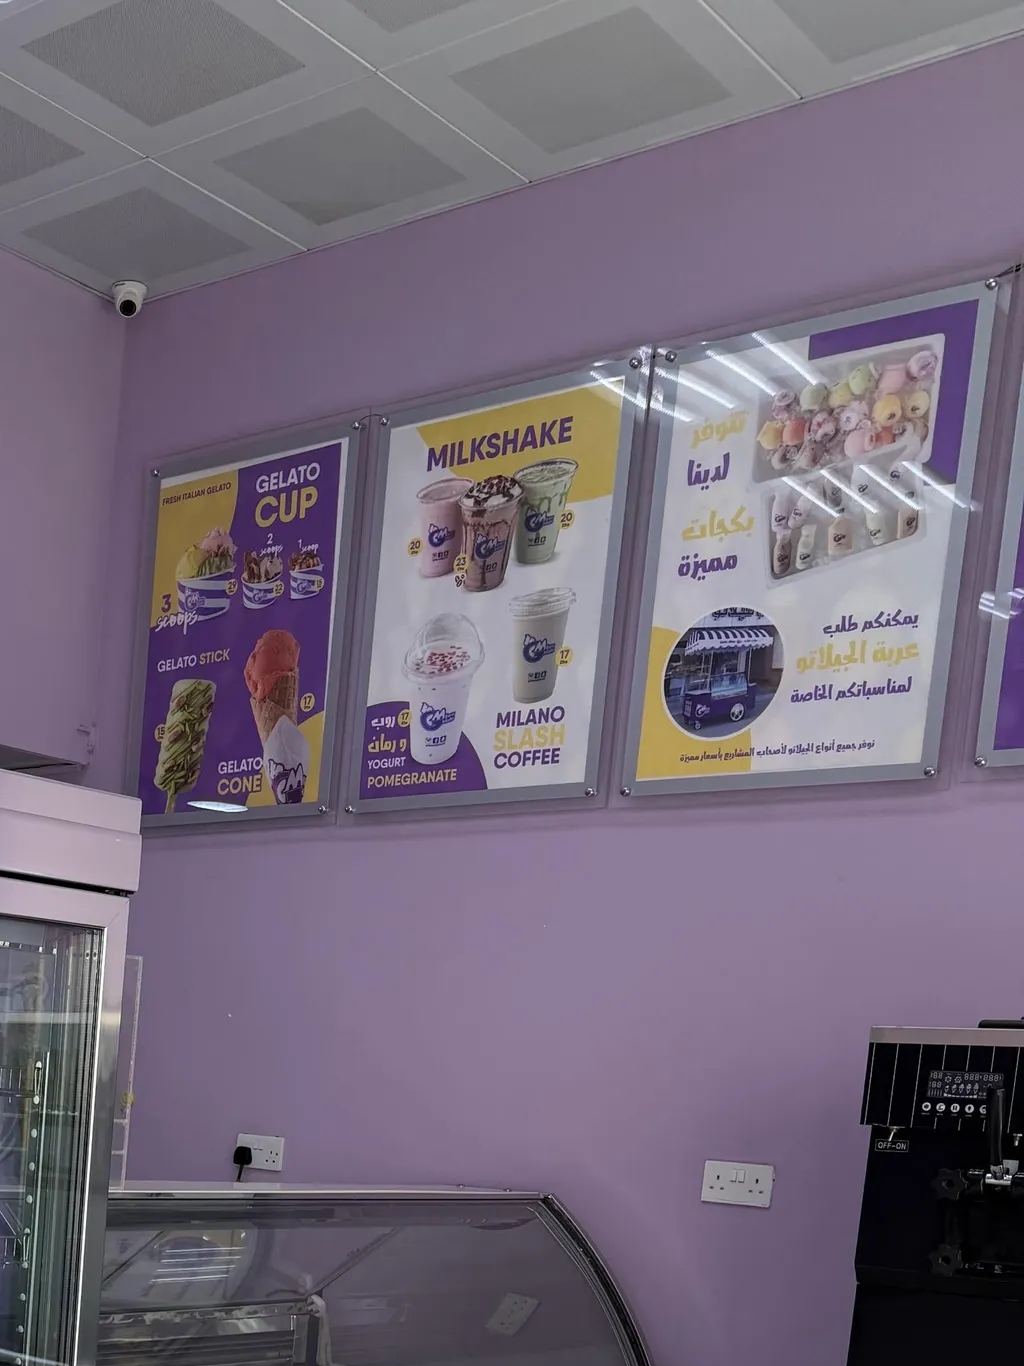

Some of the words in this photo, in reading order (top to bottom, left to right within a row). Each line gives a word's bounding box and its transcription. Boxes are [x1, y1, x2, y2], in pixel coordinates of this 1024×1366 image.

[427, 415, 574, 472] MILKSHAKE
[255, 462, 321, 494] GELATO
[687, 452, 730, 491] لدينا
[162, 494, 181, 506] FRESH
[182, 488, 206, 501] ITALIAN
[206, 482, 232, 496] GELATO
[255, 486, 319, 528] CUP
[561, 512, 572, 523] 20
[681, 504, 755, 542] بكجات
[266, 533, 273, 545] 2
[298, 538, 303, 549] 1
[301, 543, 319, 554] scoop
[410, 540, 421, 550] 20
[259, 544, 283, 557] scoops
[456, 556, 467, 567] 23
[678, 553, 738, 581] مميزة
[161, 593, 171, 613] 3
[154, 609, 198, 635] scoops
[823, 614, 858, 638] طلب
[861, 609, 919, 632] يمكنكم
[157, 655, 197, 672] GELATO
[199, 648, 230, 665] STICK
[560, 649, 570, 659] 17
[796, 639, 867, 674] الجيلاتو
[872, 641, 920, 668] عربة
[790, 684, 834, 703] الخاصة
[835, 676, 912, 701] لمناسباتكم
[303, 695, 312, 705] 17
[371, 716, 396, 730] روب
[401, 712, 409, 720] 17
[496, 705, 566, 729] MILANO
[157, 726, 165, 736] 15
[493, 723, 566, 752] SLASH
[368, 733, 396, 753] رمان
[836, 743, 856, 753] جميع
[217, 757, 263, 775] GELATO
[367, 756, 407, 769] YOGURT
[493, 747, 561, 769] COFFEE
[680, 753, 700, 763] مميزة
[217, 774, 262, 796] CONE
[367, 769, 457, 788] POMEGRANATE
[877, 1141, 907, 1150] OFF-ON
